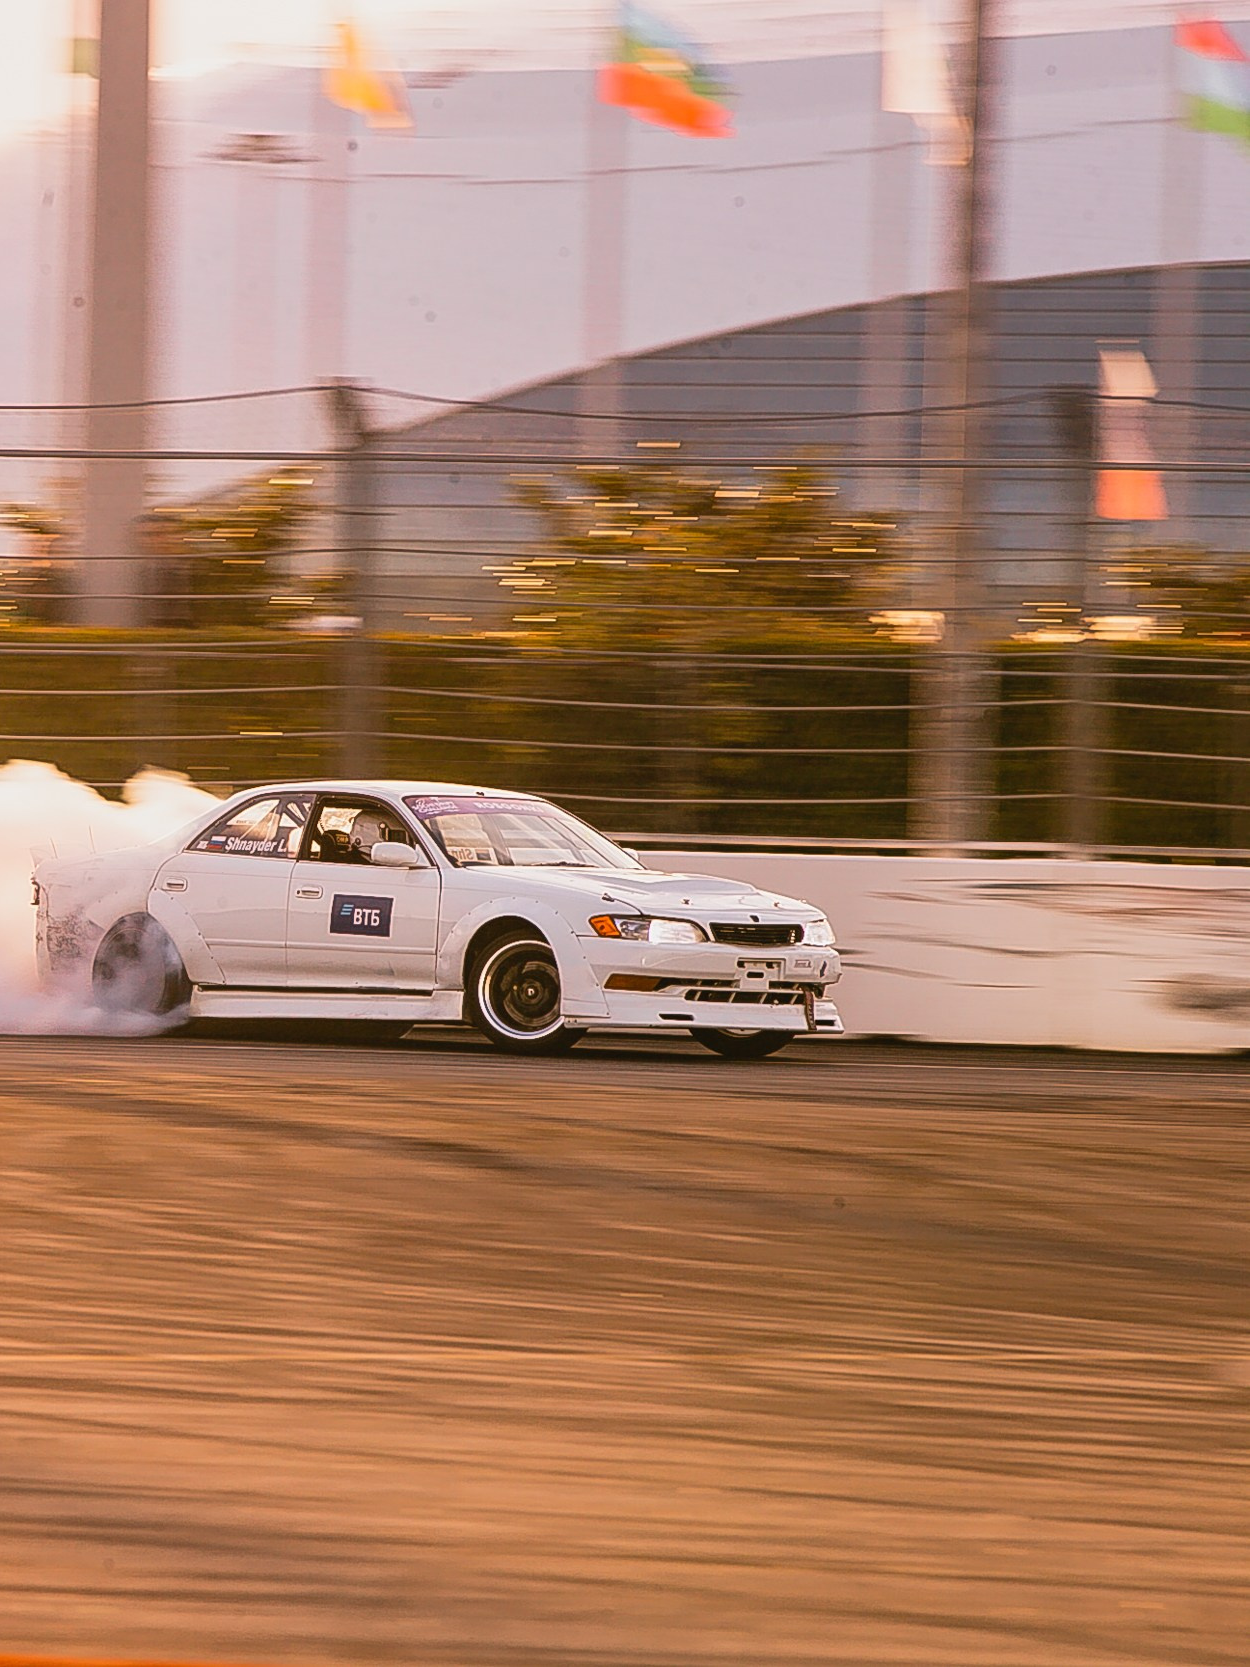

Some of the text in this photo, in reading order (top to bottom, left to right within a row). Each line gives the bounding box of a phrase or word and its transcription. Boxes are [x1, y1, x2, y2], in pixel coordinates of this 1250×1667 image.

[224, 836, 277, 855] Shnayder
[277, 838, 287, 853] L.
[353, 908, 381, 927] ВТБ
